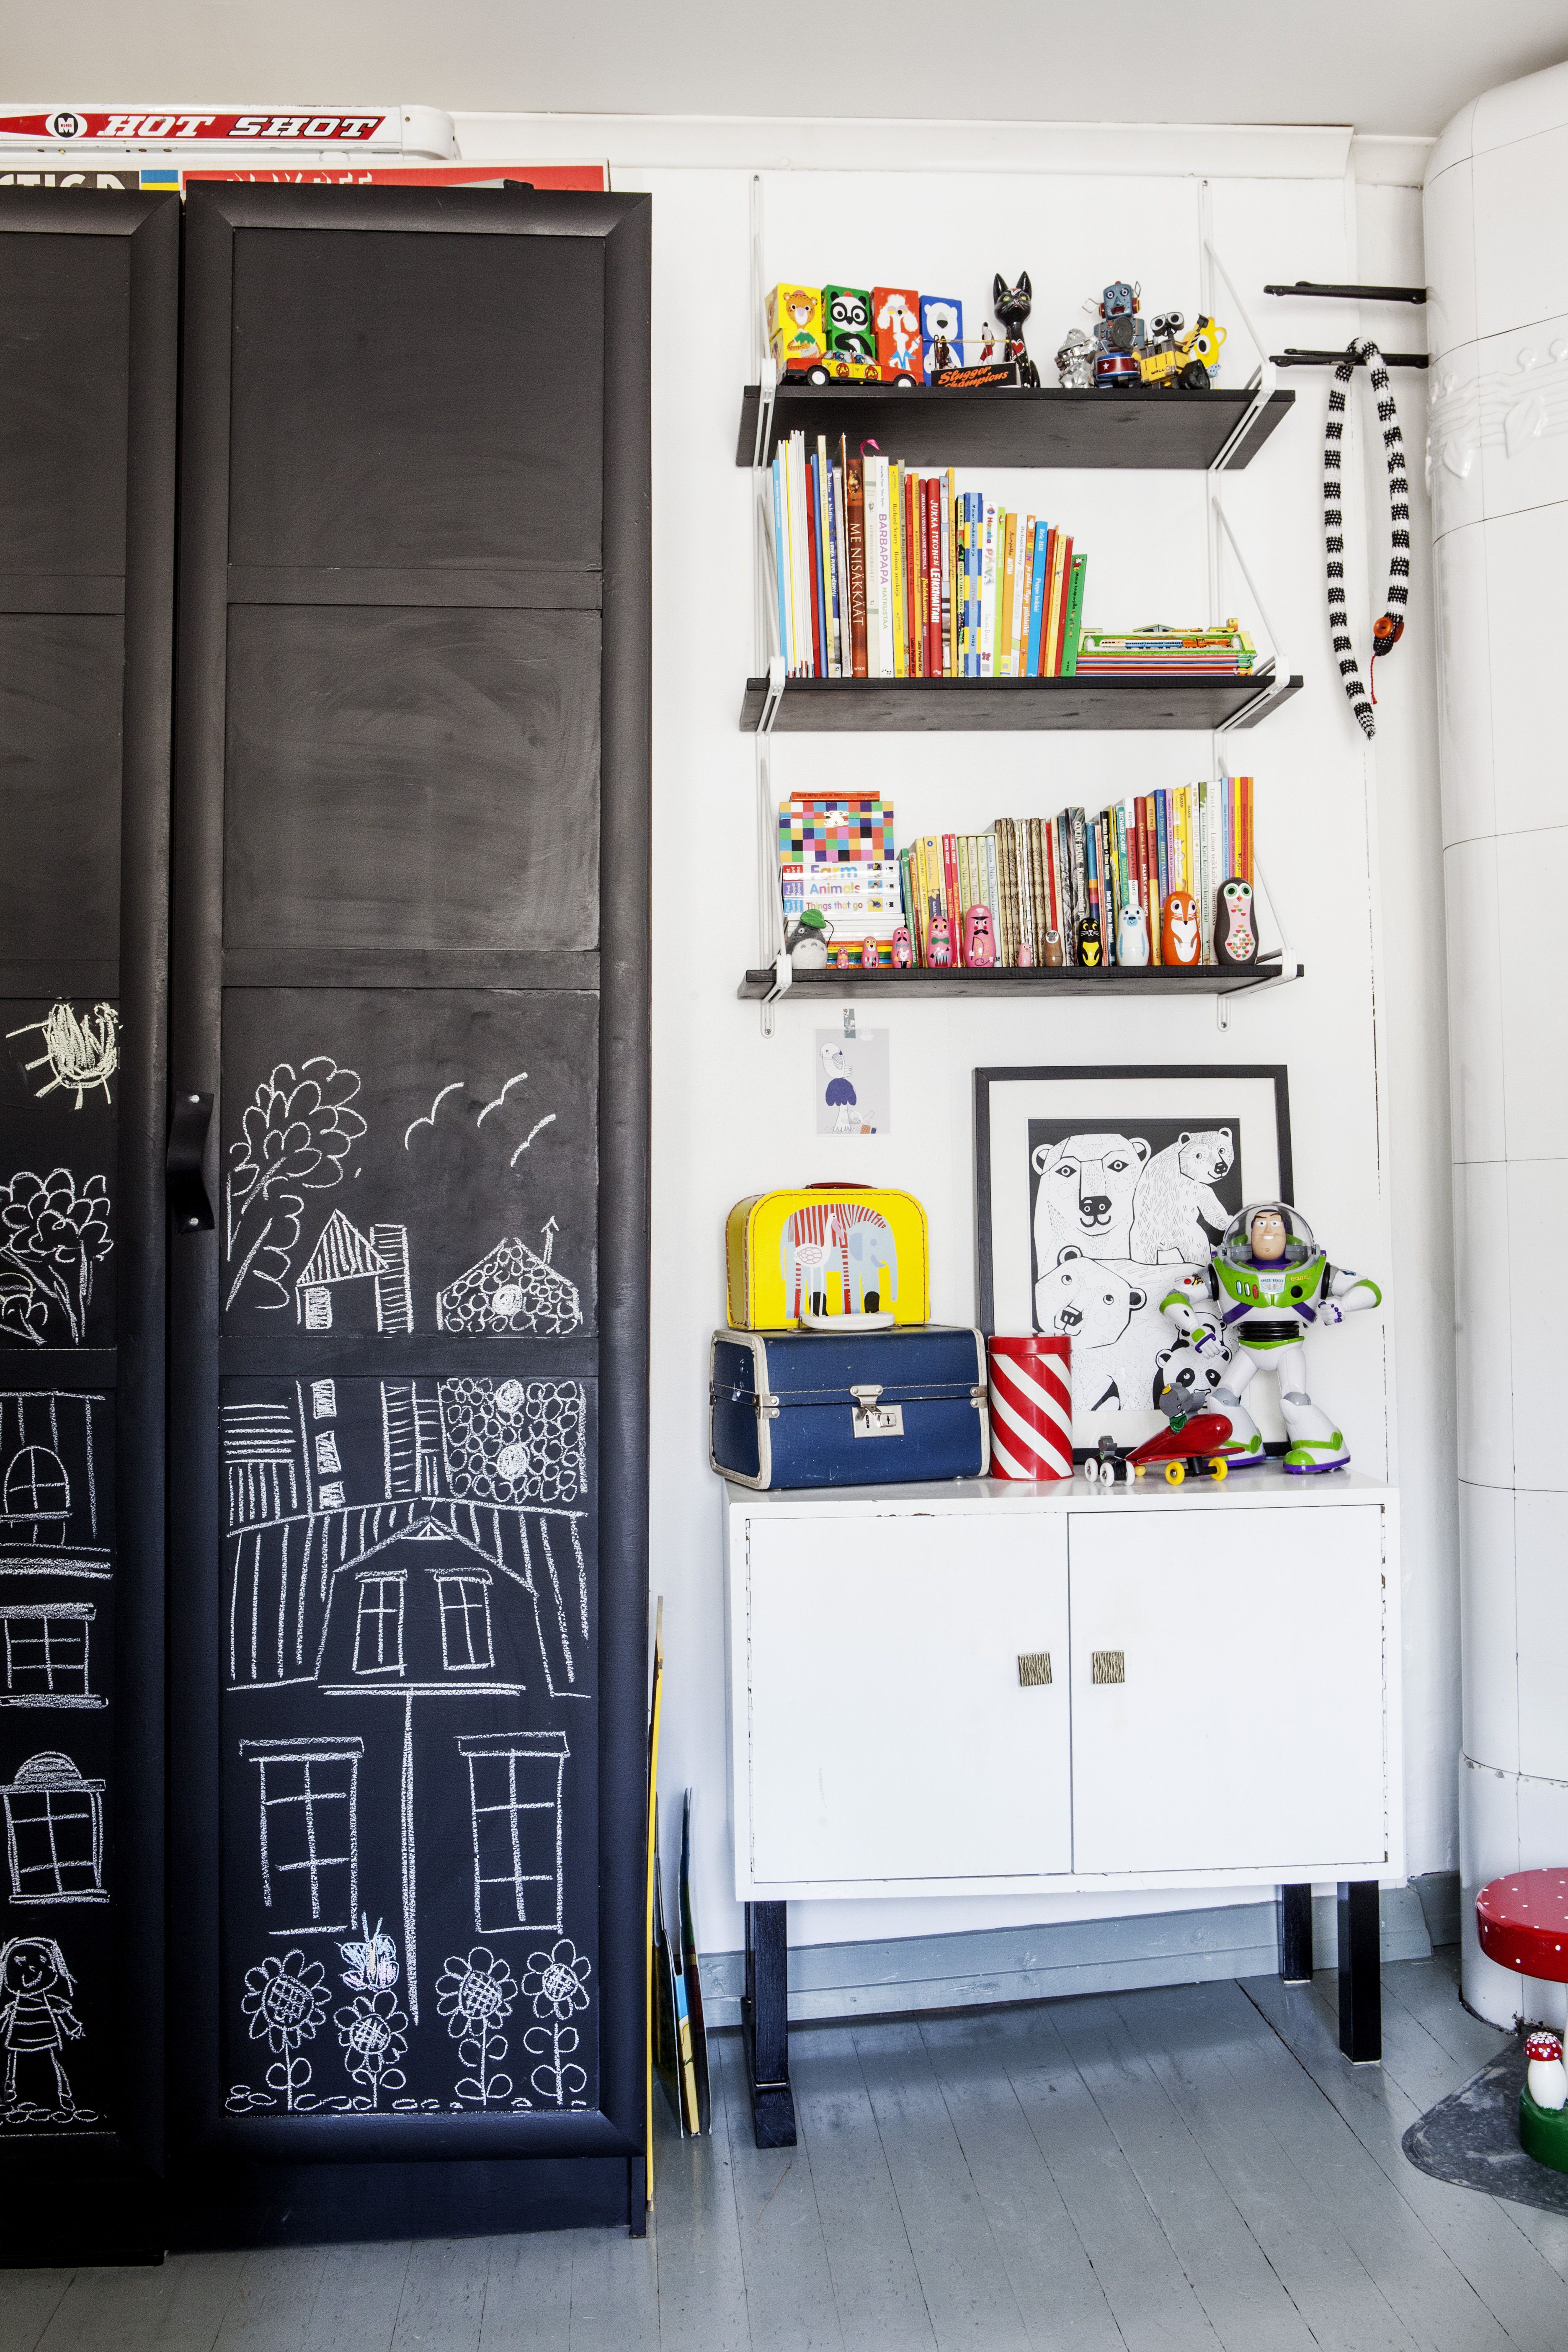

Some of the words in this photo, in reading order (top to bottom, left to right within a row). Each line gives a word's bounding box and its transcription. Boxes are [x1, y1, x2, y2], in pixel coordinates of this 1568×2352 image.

[97, 116, 217, 137] HOT
[227, 117, 381, 137] SHOT
[938, 366, 991, 384] Slugger
[850, 523, 861, 543] ME
[879, 514, 888, 584] BARBAPAPA
[984, 548, 995, 585] PÄIVÄ
[851, 548, 864, 626] NISÄKKÄÄT
[930, 568, 941, 623] LEIKKIHAITARI
[810, 865, 858, 880] Farm
[810, 882, 860, 895] Animals
[1077, 868, 1086, 912] Kaukametsän
[806, 901, 831, 911] Things
[834, 901, 850, 909] that
[854, 902, 863, 911] go
